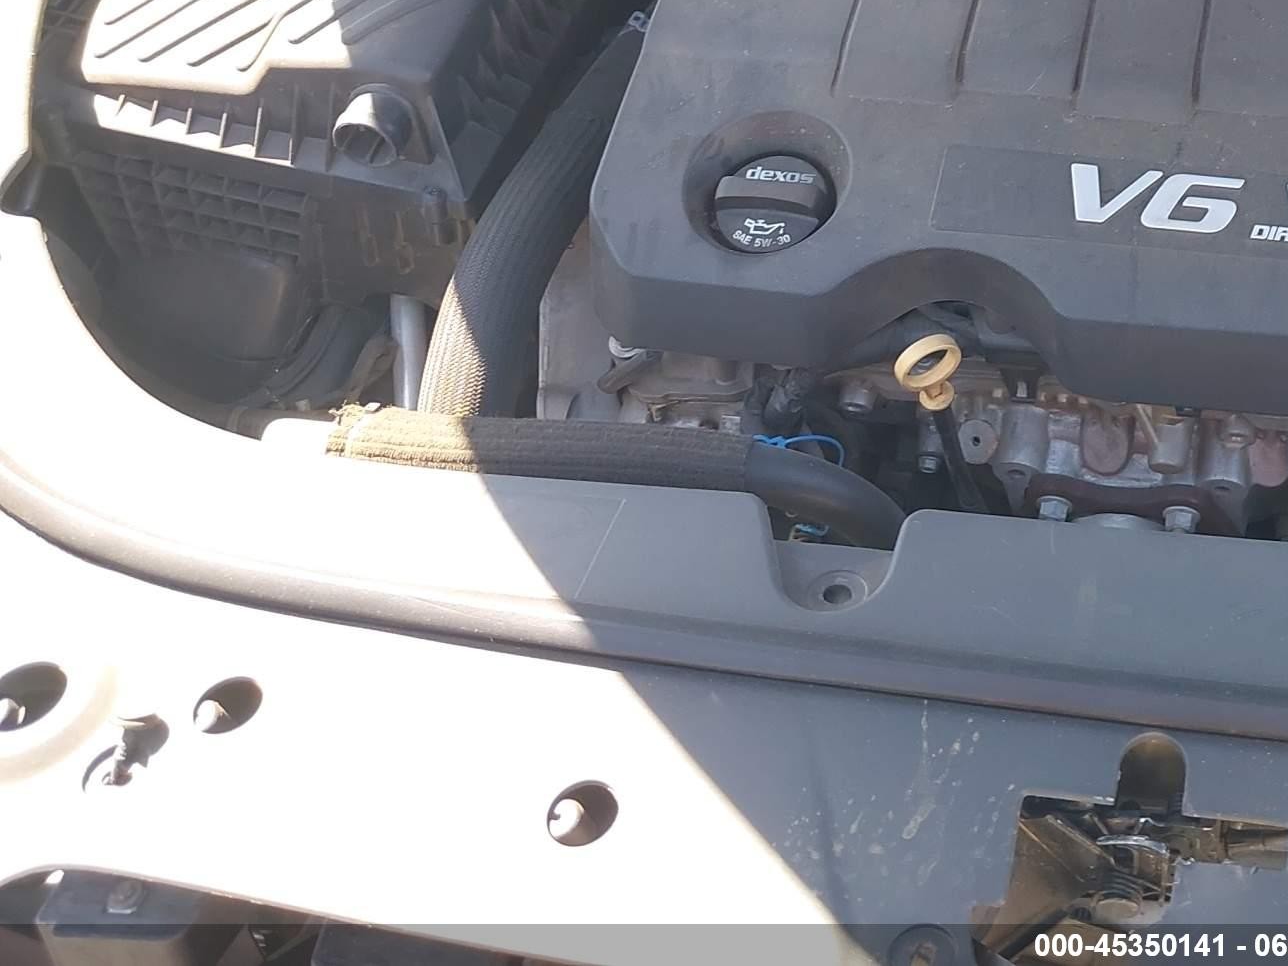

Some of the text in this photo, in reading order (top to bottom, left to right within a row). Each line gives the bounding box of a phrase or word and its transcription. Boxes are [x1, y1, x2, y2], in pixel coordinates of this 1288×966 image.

[746, 166, 816, 183] dexos
[1070, 163, 1246, 234] V6
[733, 230, 791, 247] SAE 5W-30
